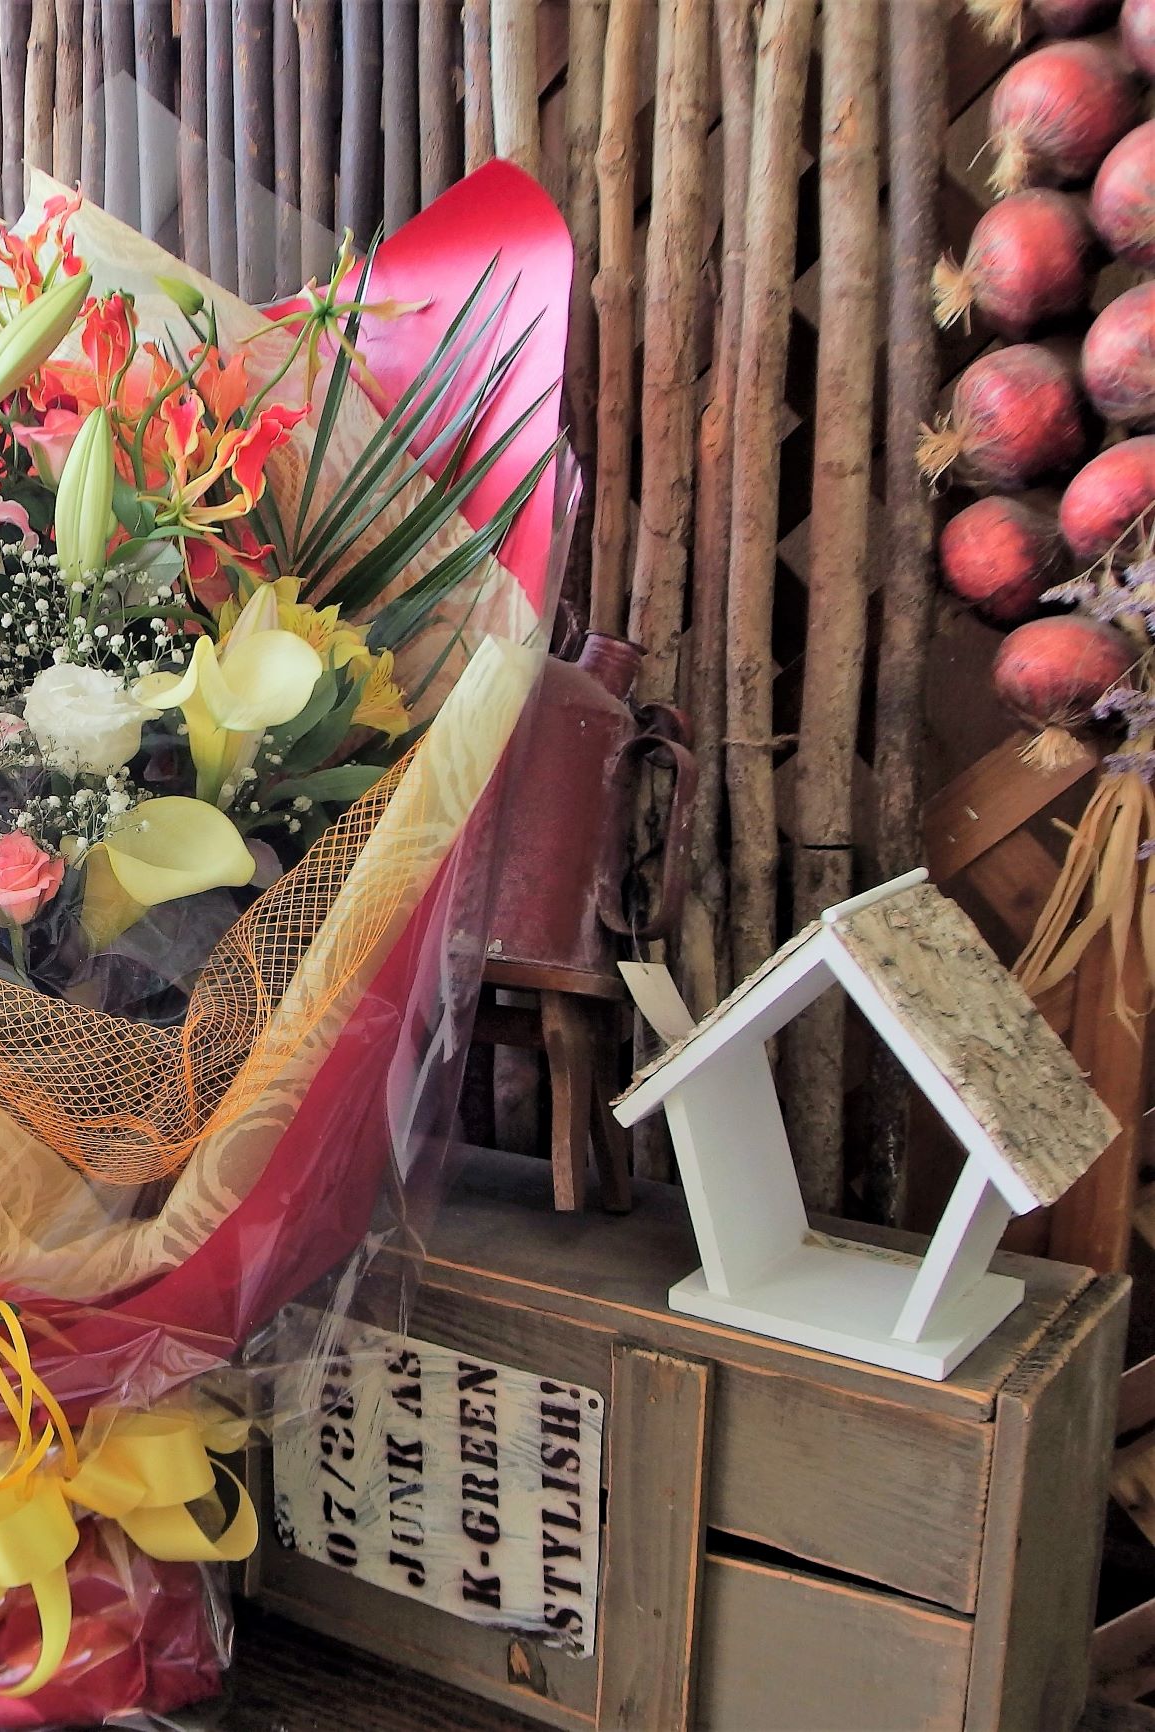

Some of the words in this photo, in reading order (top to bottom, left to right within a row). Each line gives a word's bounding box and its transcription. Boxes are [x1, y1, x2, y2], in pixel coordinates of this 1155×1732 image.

[387, 1433, 426, 1586] JUNK
[458, 1361, 501, 1609] K-GREEN
[540, 1381, 583, 1636] STYLISH!
